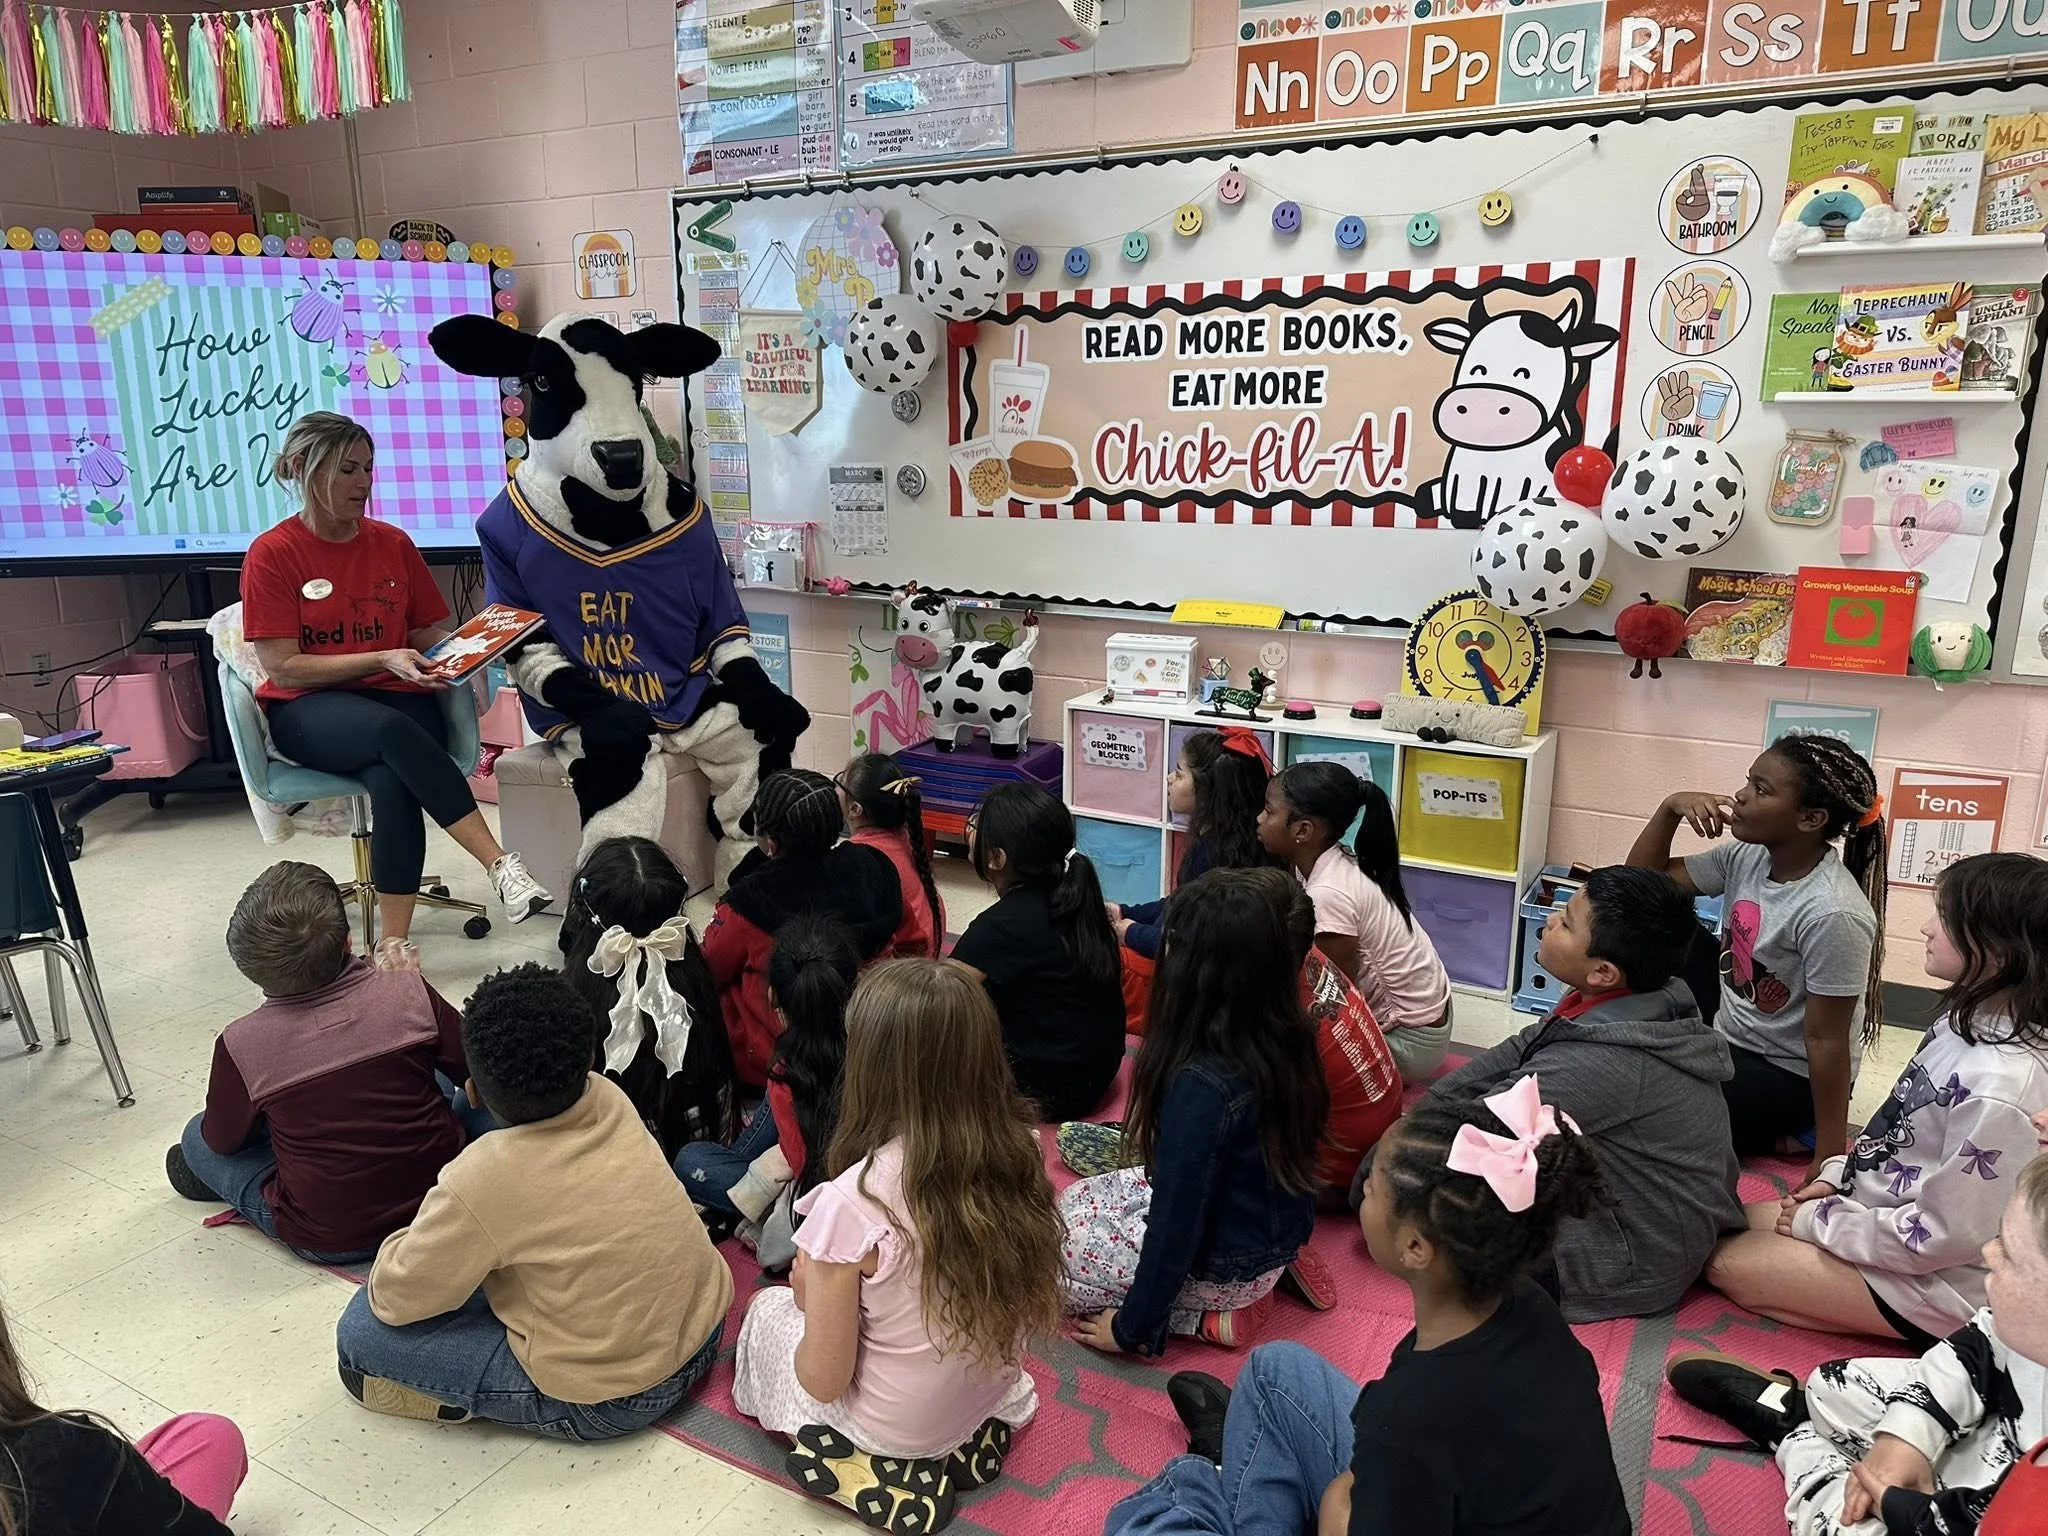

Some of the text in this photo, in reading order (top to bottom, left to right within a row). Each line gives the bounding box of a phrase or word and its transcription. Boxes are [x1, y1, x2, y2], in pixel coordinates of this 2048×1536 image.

[709, 14, 748, 30] SILENT E
[845, 7, 852, 21] 3
[1719, 2, 1803, 67] Ss
[1842, 0, 1920, 56] Tt
[914, 45, 936, 57] BLEND
[1617, 15, 1697, 80] Rr
[848, 51, 856, 64] 4
[1506, 20, 1592, 94] Qq
[710, 59, 768, 76] VOWEL TEAM
[1420, 33, 1491, 102] Pp
[1325, 49, 1399, 106] Oo
[808, 90, 823, 101] girl
[1244, 60, 1309, 116] Nn
[806, 102, 826, 111] barn
[849, 94, 857, 107] 5
[951, 114, 970, 125] word
[982, 112, 995, 123] the
[878, 136, 898, 145] would
[1991, 124, 2026, 152] My
[714, 144, 779, 160] CONSONANT LE
[878, 145, 889, 154] pet
[409, 222, 435, 233] BACK TO
[409, 230, 434, 241] SCHOOL
[1679, 220, 1738, 240] BATHROOM
[578, 251, 630, 269] CLASSROOM
[805, 245, 857, 286] Mrs
[1853, 292, 1949, 316] LEPRECHAUN
[1974, 299, 2014, 317] UNCLE
[1968, 304, 2026, 326] LEPHANT
[757, 332, 793, 350] IT'S A
[1085, 312, 1409, 360] READ MORE BOOKS,
[1679, 324, 1716, 342] PENCIL
[156, 311, 272, 378] How
[746, 348, 813, 365] BEAUTIFUL
[751, 364, 777, 379] DAY
[1842, 356, 1949, 379] EASTER BUNNY
[746, 378, 811, 395] LEARNING
[1172, 369, 1325, 407] EAT MORE
[151, 364, 311, 438] Lucky
[1666, 422, 1704, 438] DRINK
[1095, 412, 1408, 493] Chick-fil-A!
[143, 445, 239, 508] Are
[844, 469, 868, 477] MARCH
[1698, 575, 1796, 597] Magic School Bu
[1803, 580, 1915, 595] Growing Vegetable Soup
[580, 590, 634, 629] EAT
[1451, 605, 1462, 621] 11
[1472, 600, 1488, 616] 12
[301, 615, 384, 647] Red fish
[1427, 622, 1444, 638] 10
[1515, 626, 1527, 643] 2
[755, 636, 783, 647] STORE
[583, 633, 645, 670] MOR
[1417, 644, 1429, 661] 9
[1520, 651, 1532, 667] 3
[1165, 658, 1181, 667] YOU
[1165, 671, 1180, 679] GOT
[1422, 668, 1433, 685] 8
[1507, 675, 1520, 691] 4
[1443, 686, 1455, 699] 7
[1106, 732, 1118, 741] 3D
[1090, 740, 1136, 753] GEOMETRIC
[1098, 750, 1130, 761] BLOCKS
[1433, 788, 1488, 804] POP-ITS
[1916, 788, 1980, 817] tens
[1319, 971, 1335, 1003] MONSTER
